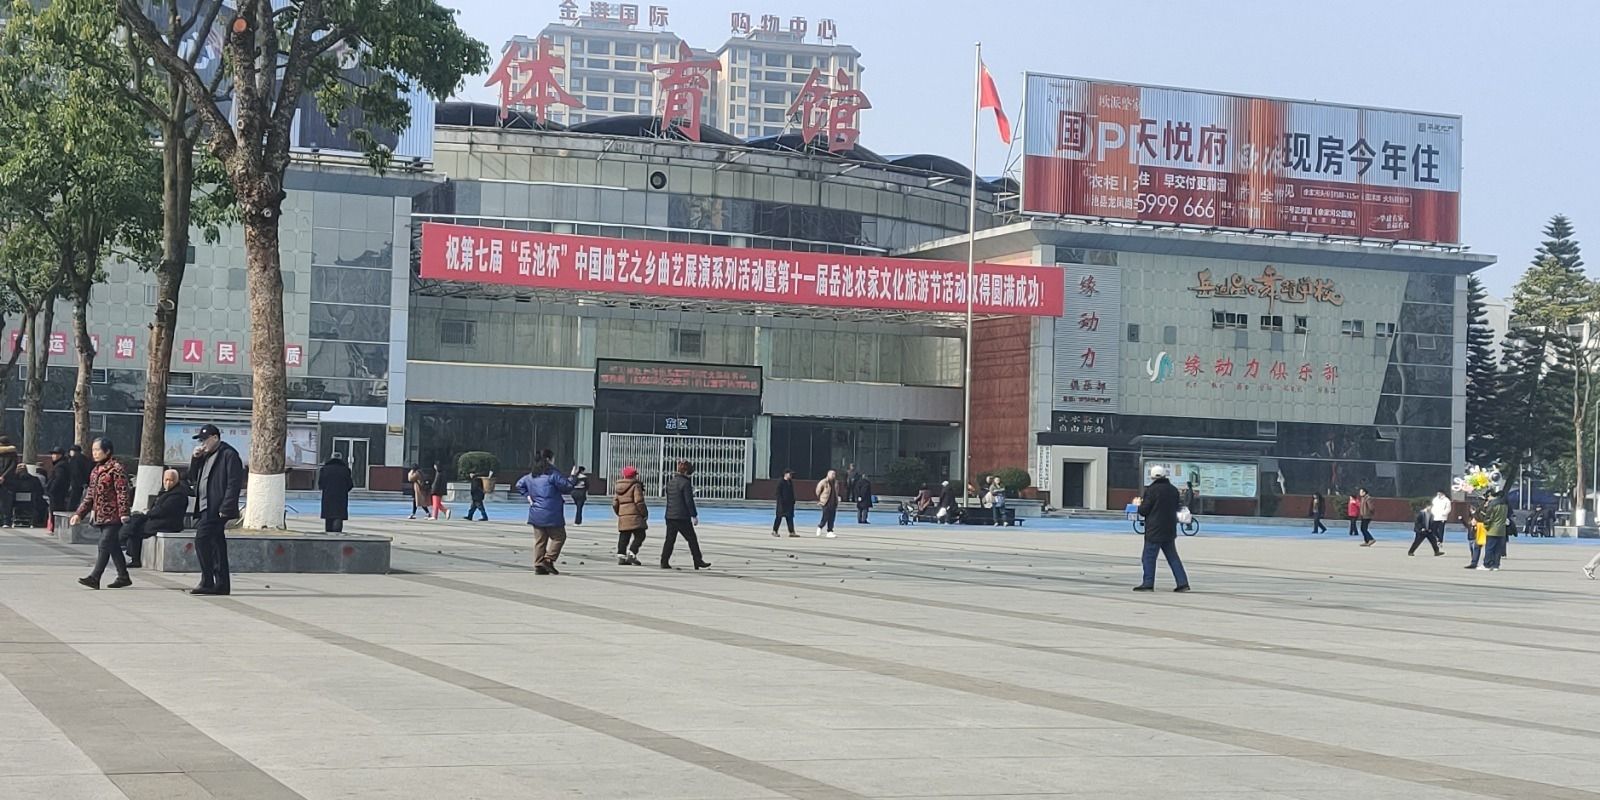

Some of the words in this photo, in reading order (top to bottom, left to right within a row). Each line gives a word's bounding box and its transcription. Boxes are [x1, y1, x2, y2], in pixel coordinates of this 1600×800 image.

[731, 12, 837, 40] 购物中心
[485, 36, 872, 152] 体育馆
[1283, 132, 1440, 184] 现房今年住
[1184, 197, 1216, 218] 666
[1078, 275, 1099, 369] 缘动力
[1184, 353, 1339, 385] 缘动力俱乐部
[665, 418, 688, 429] 东区
